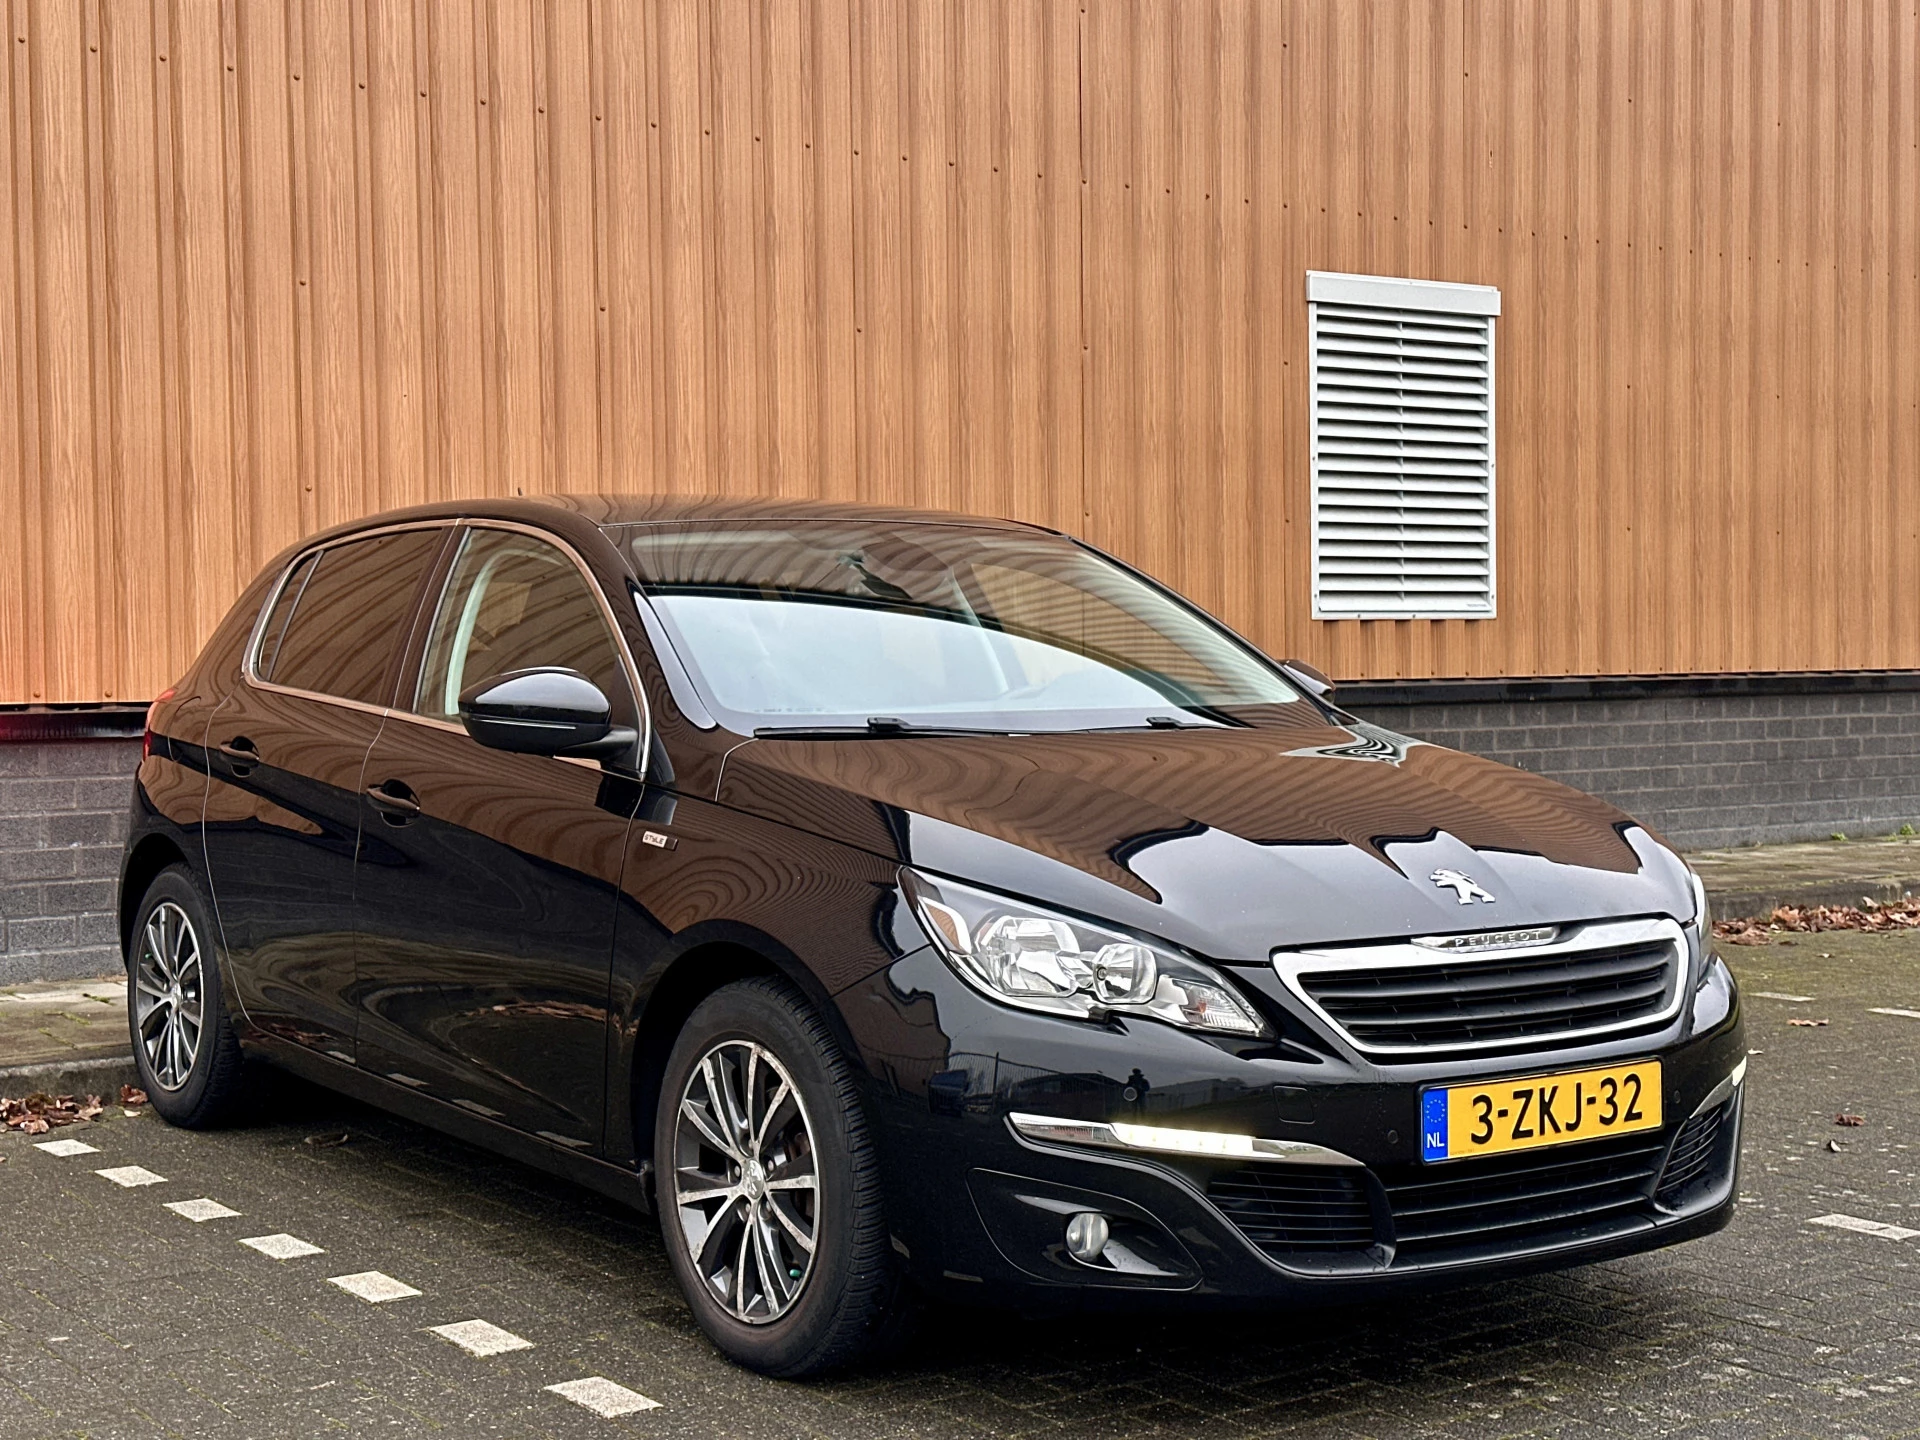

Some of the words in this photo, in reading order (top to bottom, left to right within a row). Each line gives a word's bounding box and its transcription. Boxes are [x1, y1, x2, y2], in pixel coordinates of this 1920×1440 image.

[644, 834, 665, 845] STYLE
[1455, 930, 1541, 948] PEUGEOT
[1470, 1073, 1643, 1145] 3-ZKJ-32
[1426, 1131, 1445, 1149] NL
